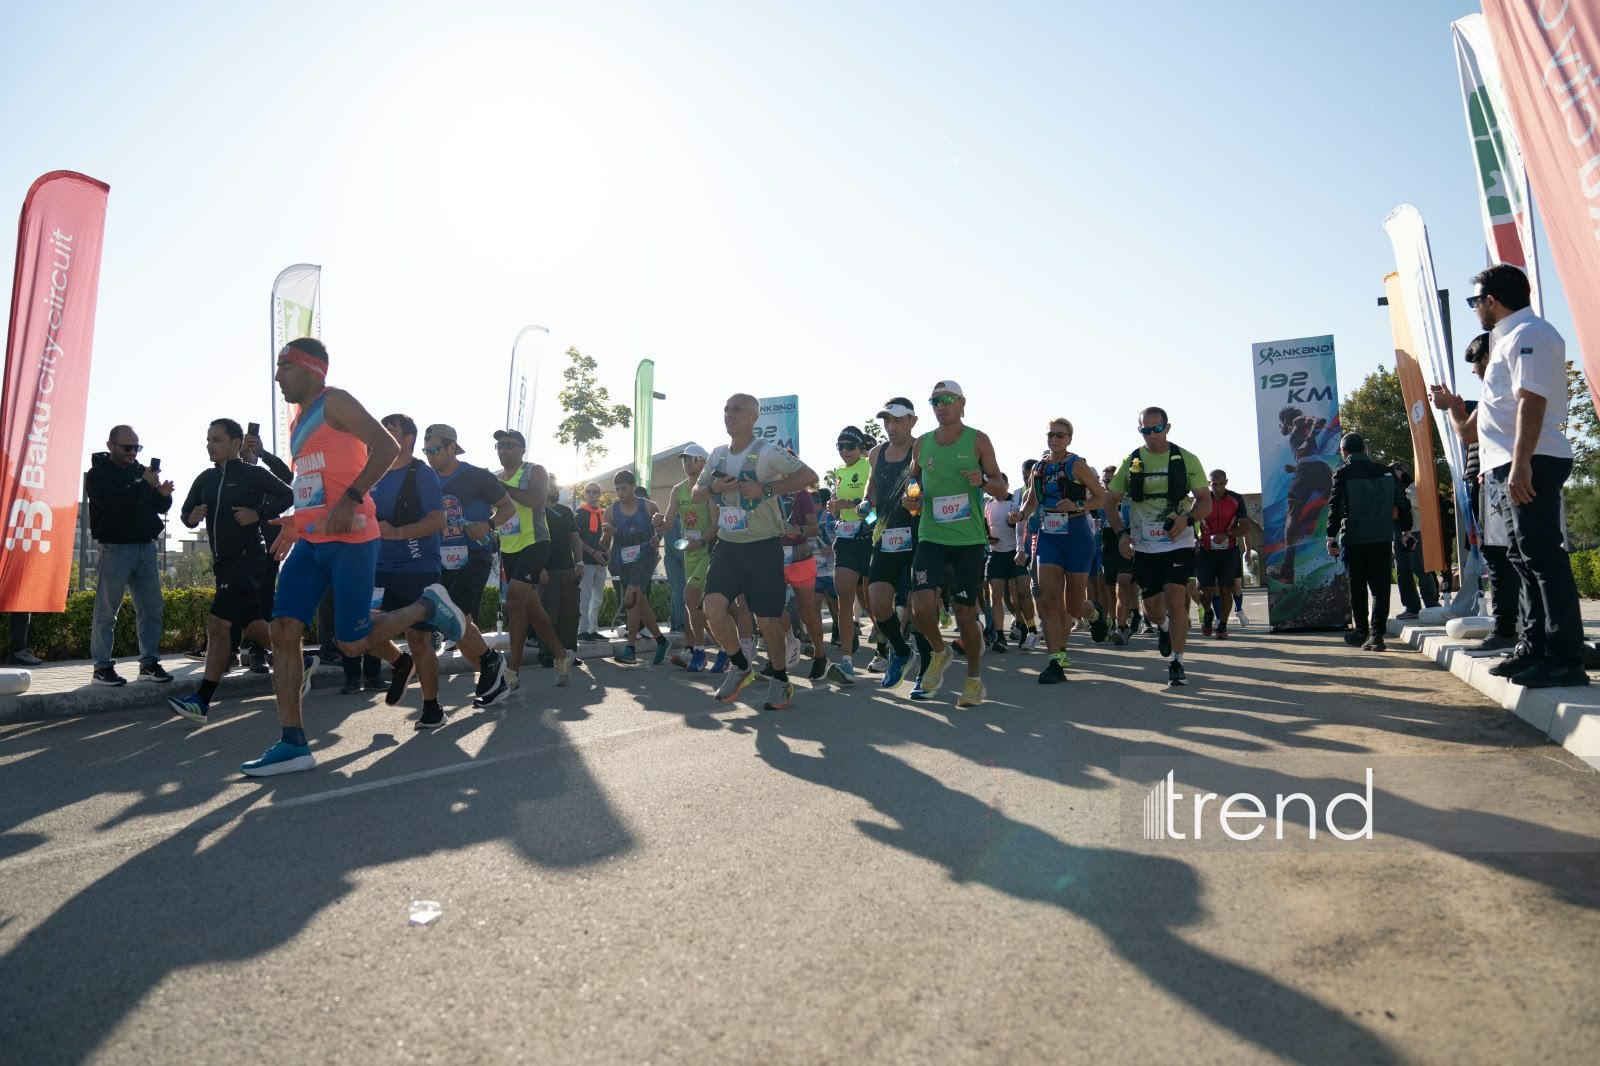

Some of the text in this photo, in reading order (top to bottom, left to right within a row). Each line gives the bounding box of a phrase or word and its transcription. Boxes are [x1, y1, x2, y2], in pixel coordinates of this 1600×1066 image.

[21, 228, 73, 488] Baku city circuit
[1261, 371, 1309, 390] 192
[1287, 386, 1333, 404] KM
[752, 426, 776, 438] 92
[298, 486, 313, 499] 087
[942, 504, 960, 515] 097
[723, 516, 738, 525] 103
[888, 536, 904, 545] 073
[446, 554, 461, 563] 064
